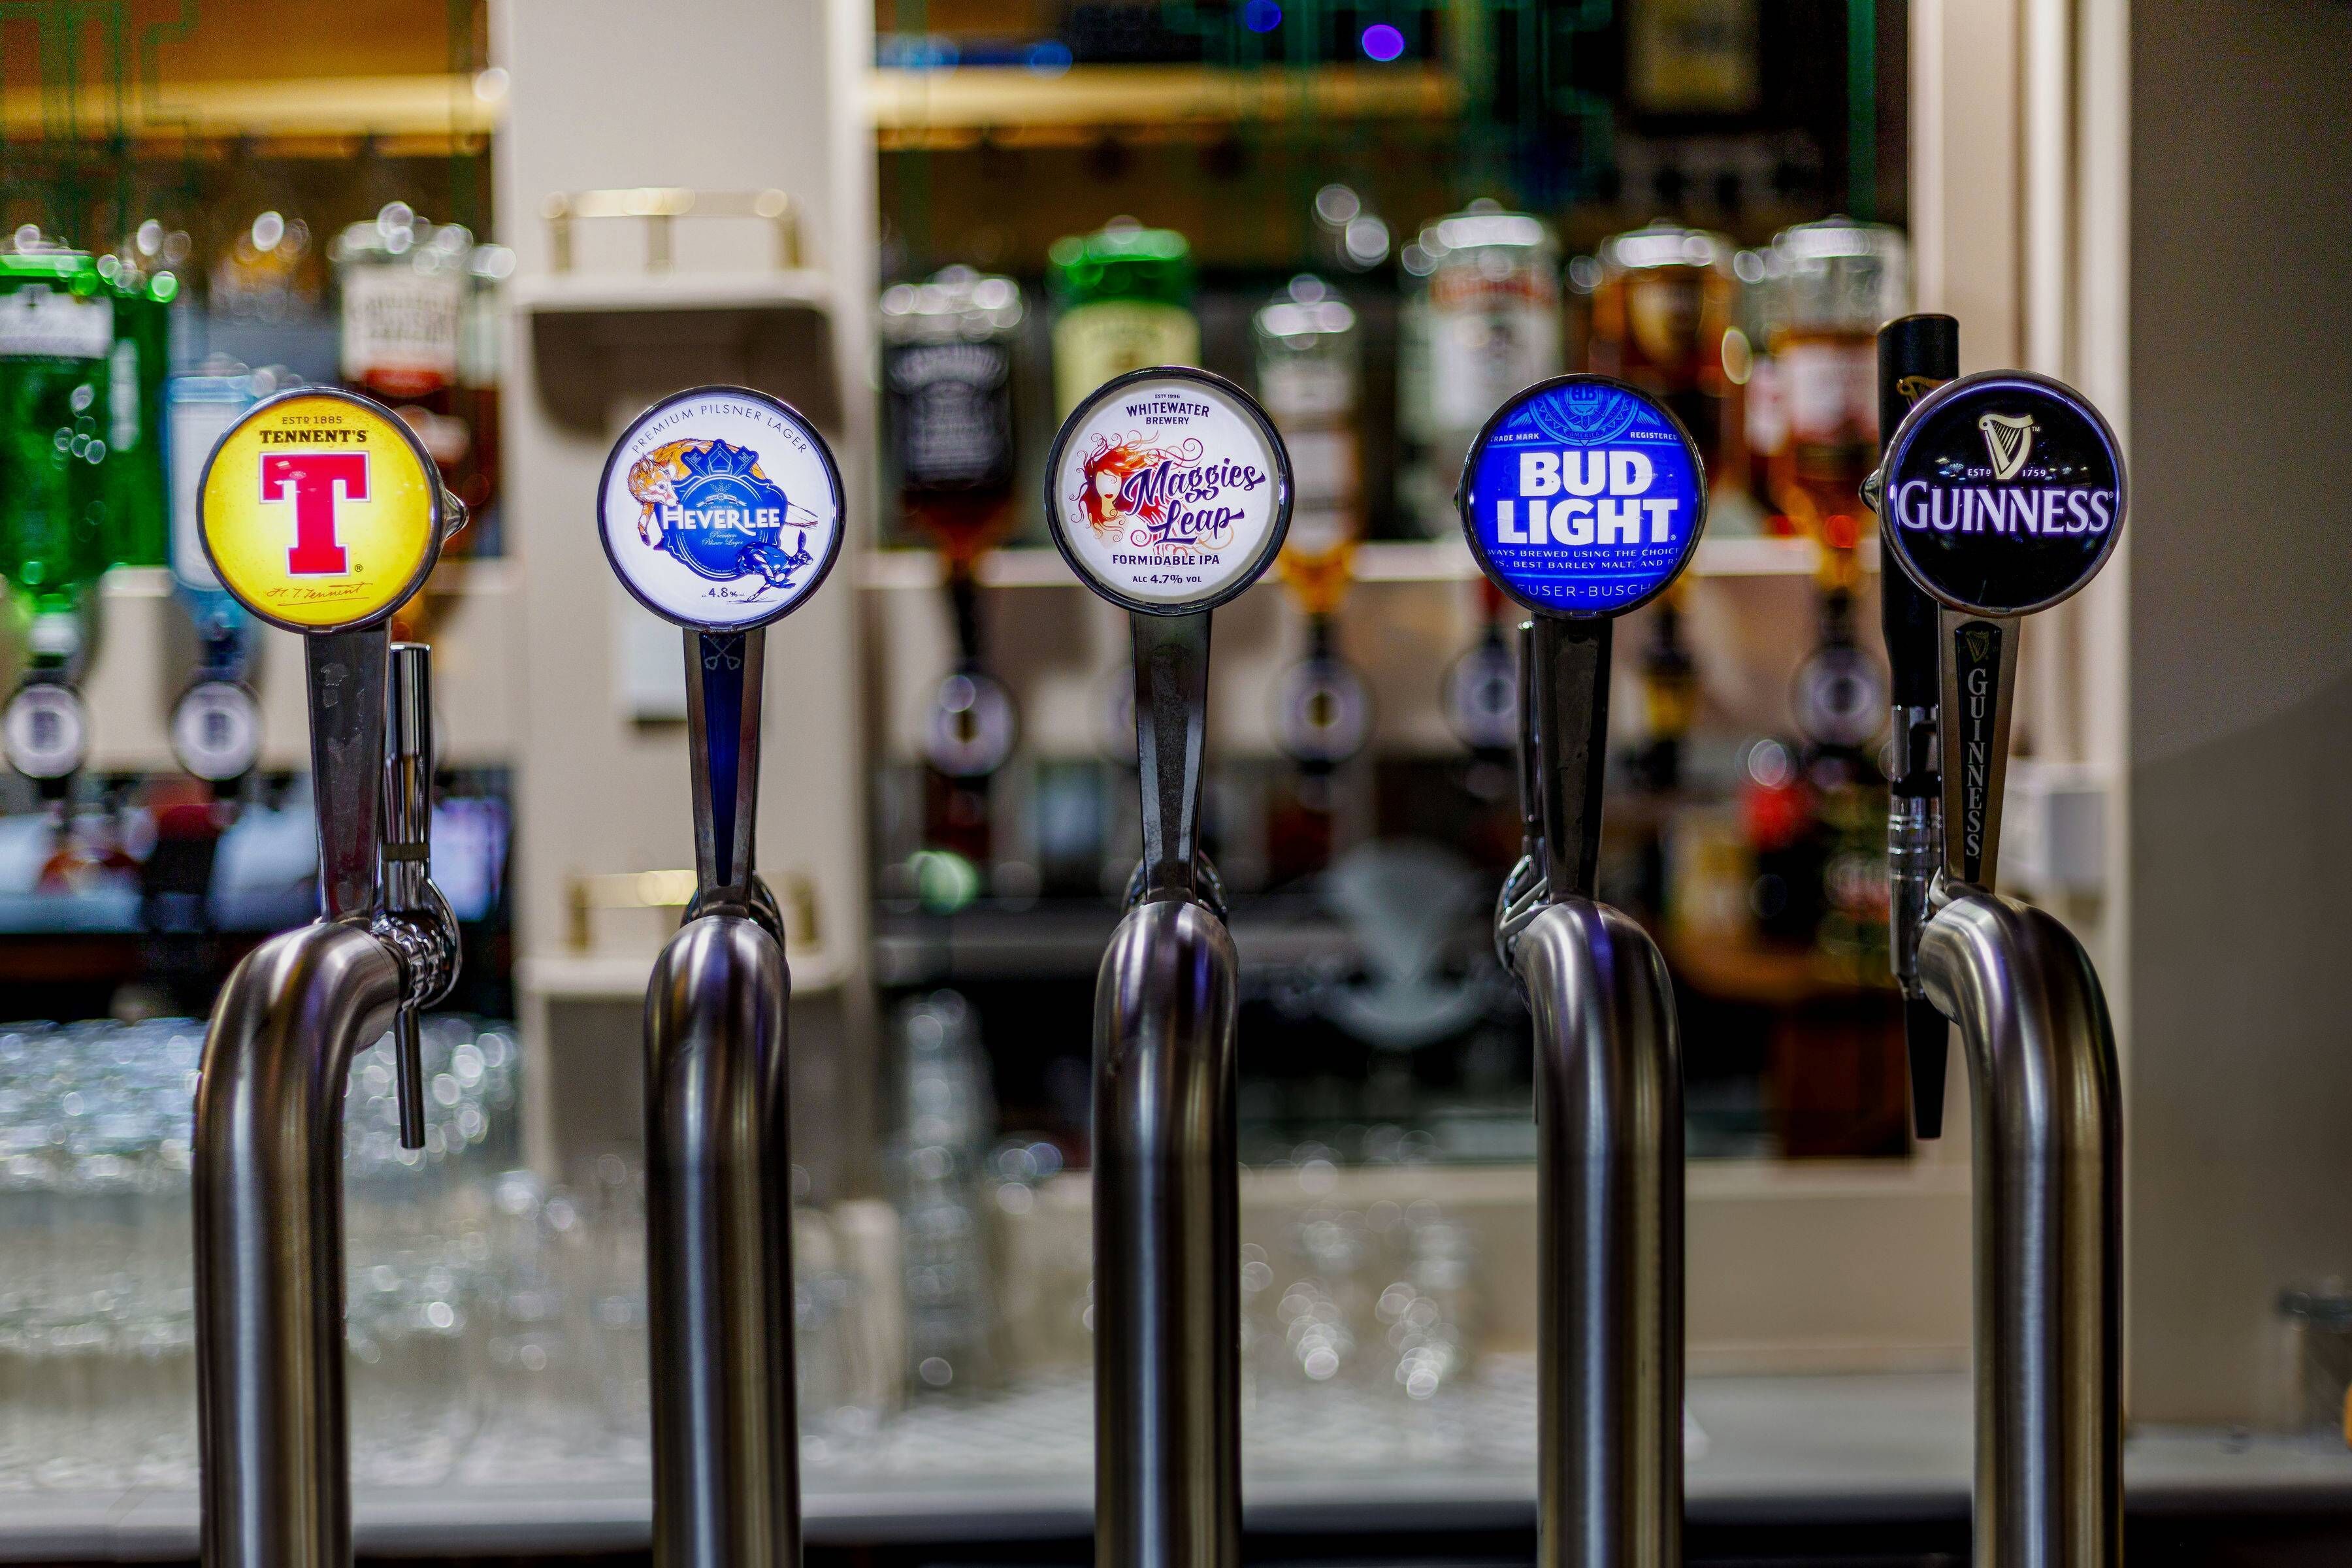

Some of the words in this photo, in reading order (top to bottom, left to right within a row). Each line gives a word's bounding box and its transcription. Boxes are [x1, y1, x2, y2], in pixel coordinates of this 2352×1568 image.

[313, 416, 342, 425] 1885
[632, 408, 694, 453] PREMIUM
[701, 404, 762, 421] PILSNER
[767, 417, 807, 453] LAGER
[1126, 402, 1210, 417] WHITEWATER
[259, 429, 368, 444] TENNENT'S
[1124, 457, 1266, 515] Maggies
[1519, 451, 1653, 497] BUD
[259, 451, 370, 577] T
[662, 504, 781, 536] HEVERLEE
[1147, 499, 1245, 547] Leap
[1496, 498, 1678, 546] LIGHT
[1898, 480, 2110, 532] GUINNESS
[725, 538, 744, 547] Lager
[1113, 554, 1196, 565] FORMIDABLE
[1200, 555, 1220, 564] IPA
[1150, 574, 1183, 584] 4.7%
[1966, 668, 1989, 857] GUINNESS
